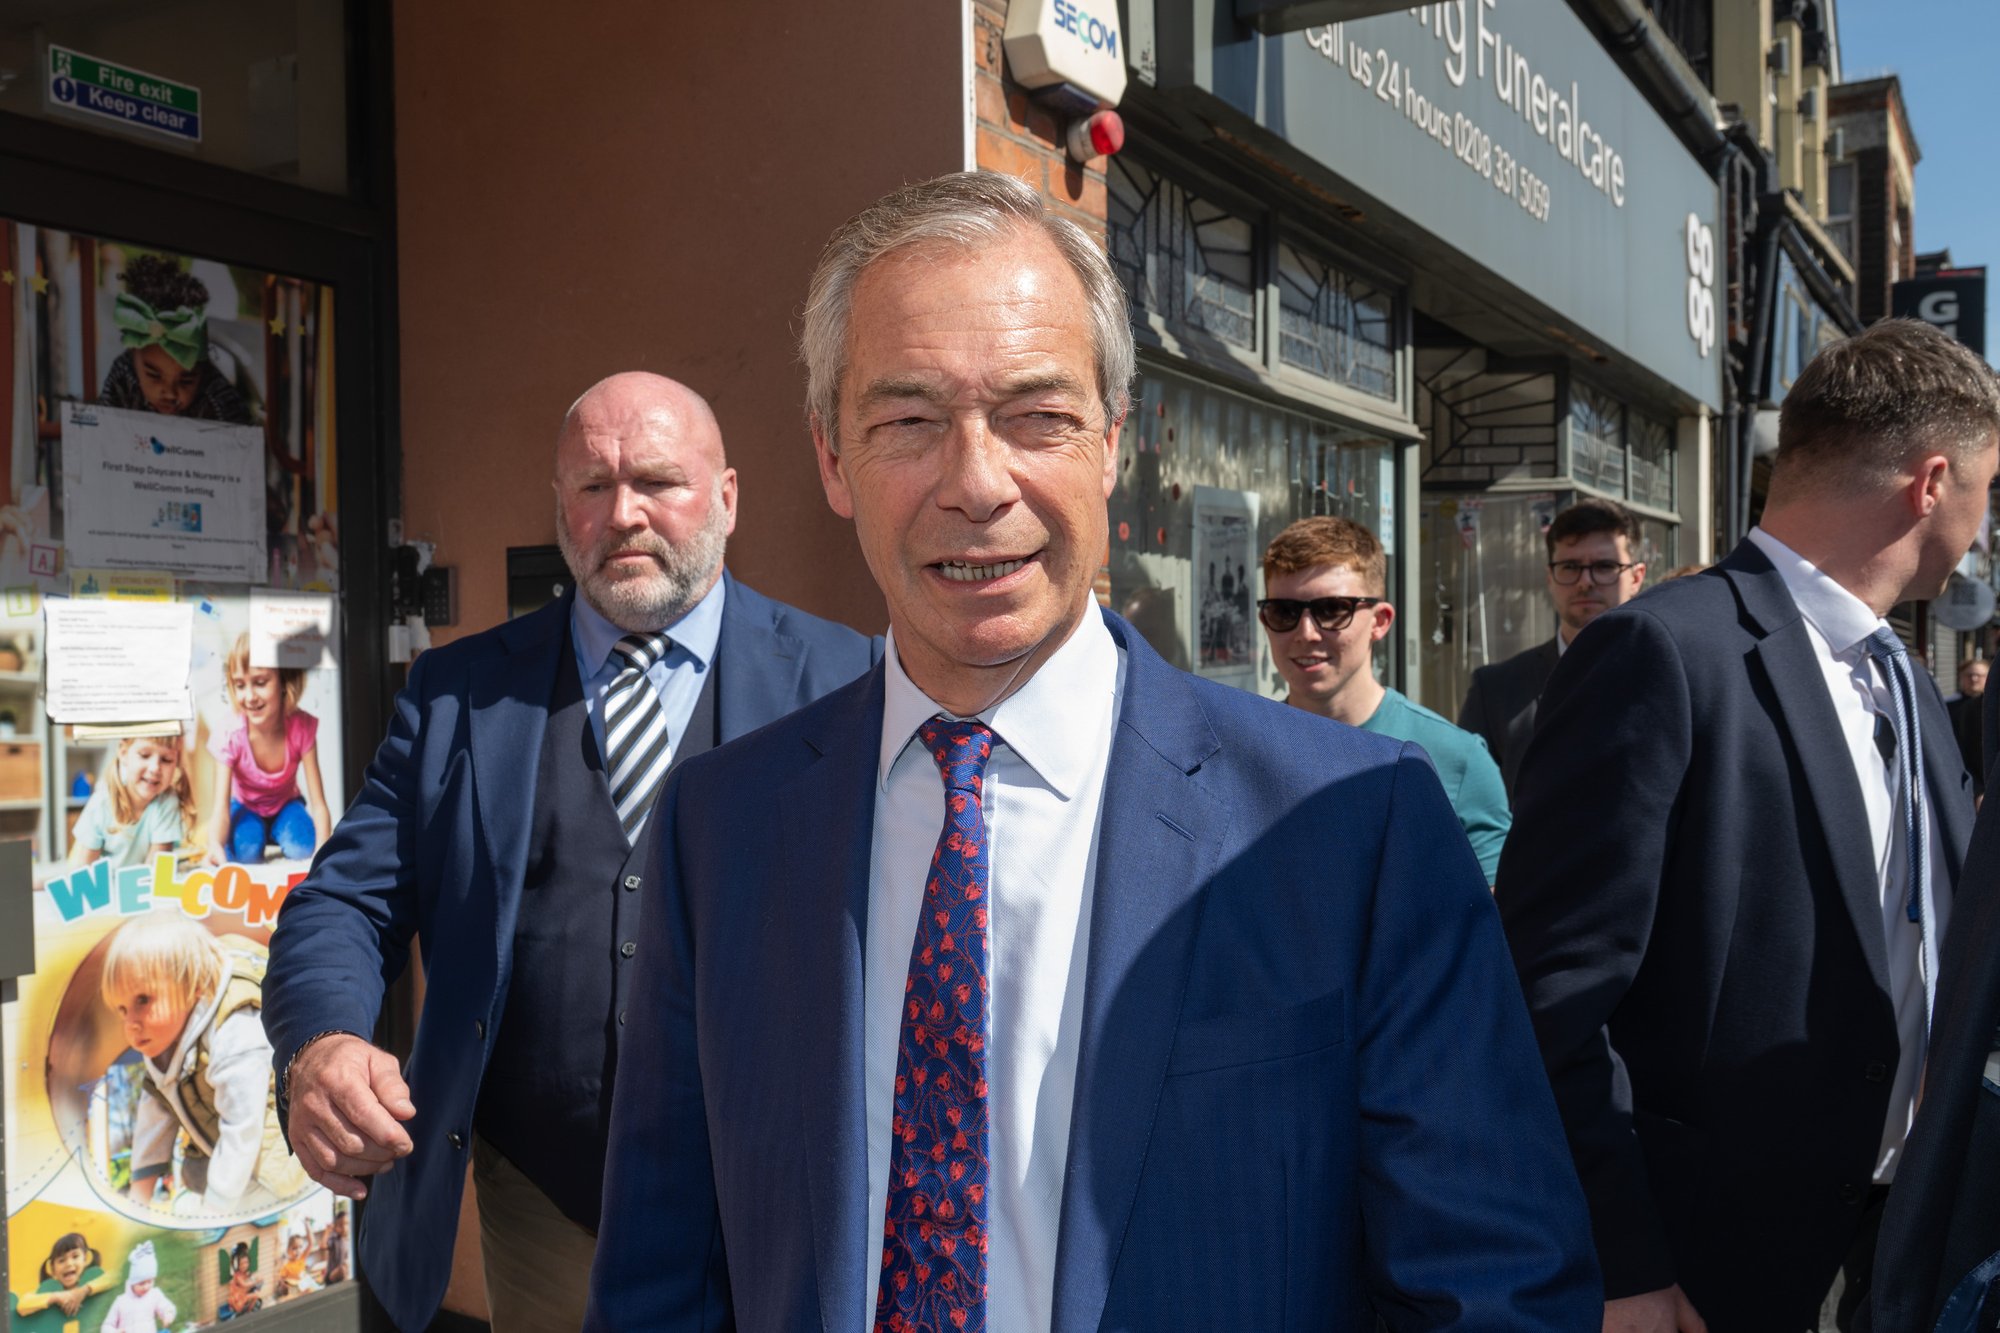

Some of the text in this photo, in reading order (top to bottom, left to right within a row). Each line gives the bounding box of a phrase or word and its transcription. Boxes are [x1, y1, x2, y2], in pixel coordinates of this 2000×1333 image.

[1053, 0, 1116, 59] SECOM
[89, 87, 187, 130] Keep clear
[99, 66, 173, 104] Fire exit
[1477, 0, 1625, 207] Funeralcare
[1305, 21, 1550, 222] Call us 24 hours 0208 331 5059
[102, 460, 123, 472] First
[125, 464, 145, 475] Step
[147, 465, 183, 478] Daycare
[192, 470, 226, 484] Nursery
[48, 855, 307, 924] WELCOM
